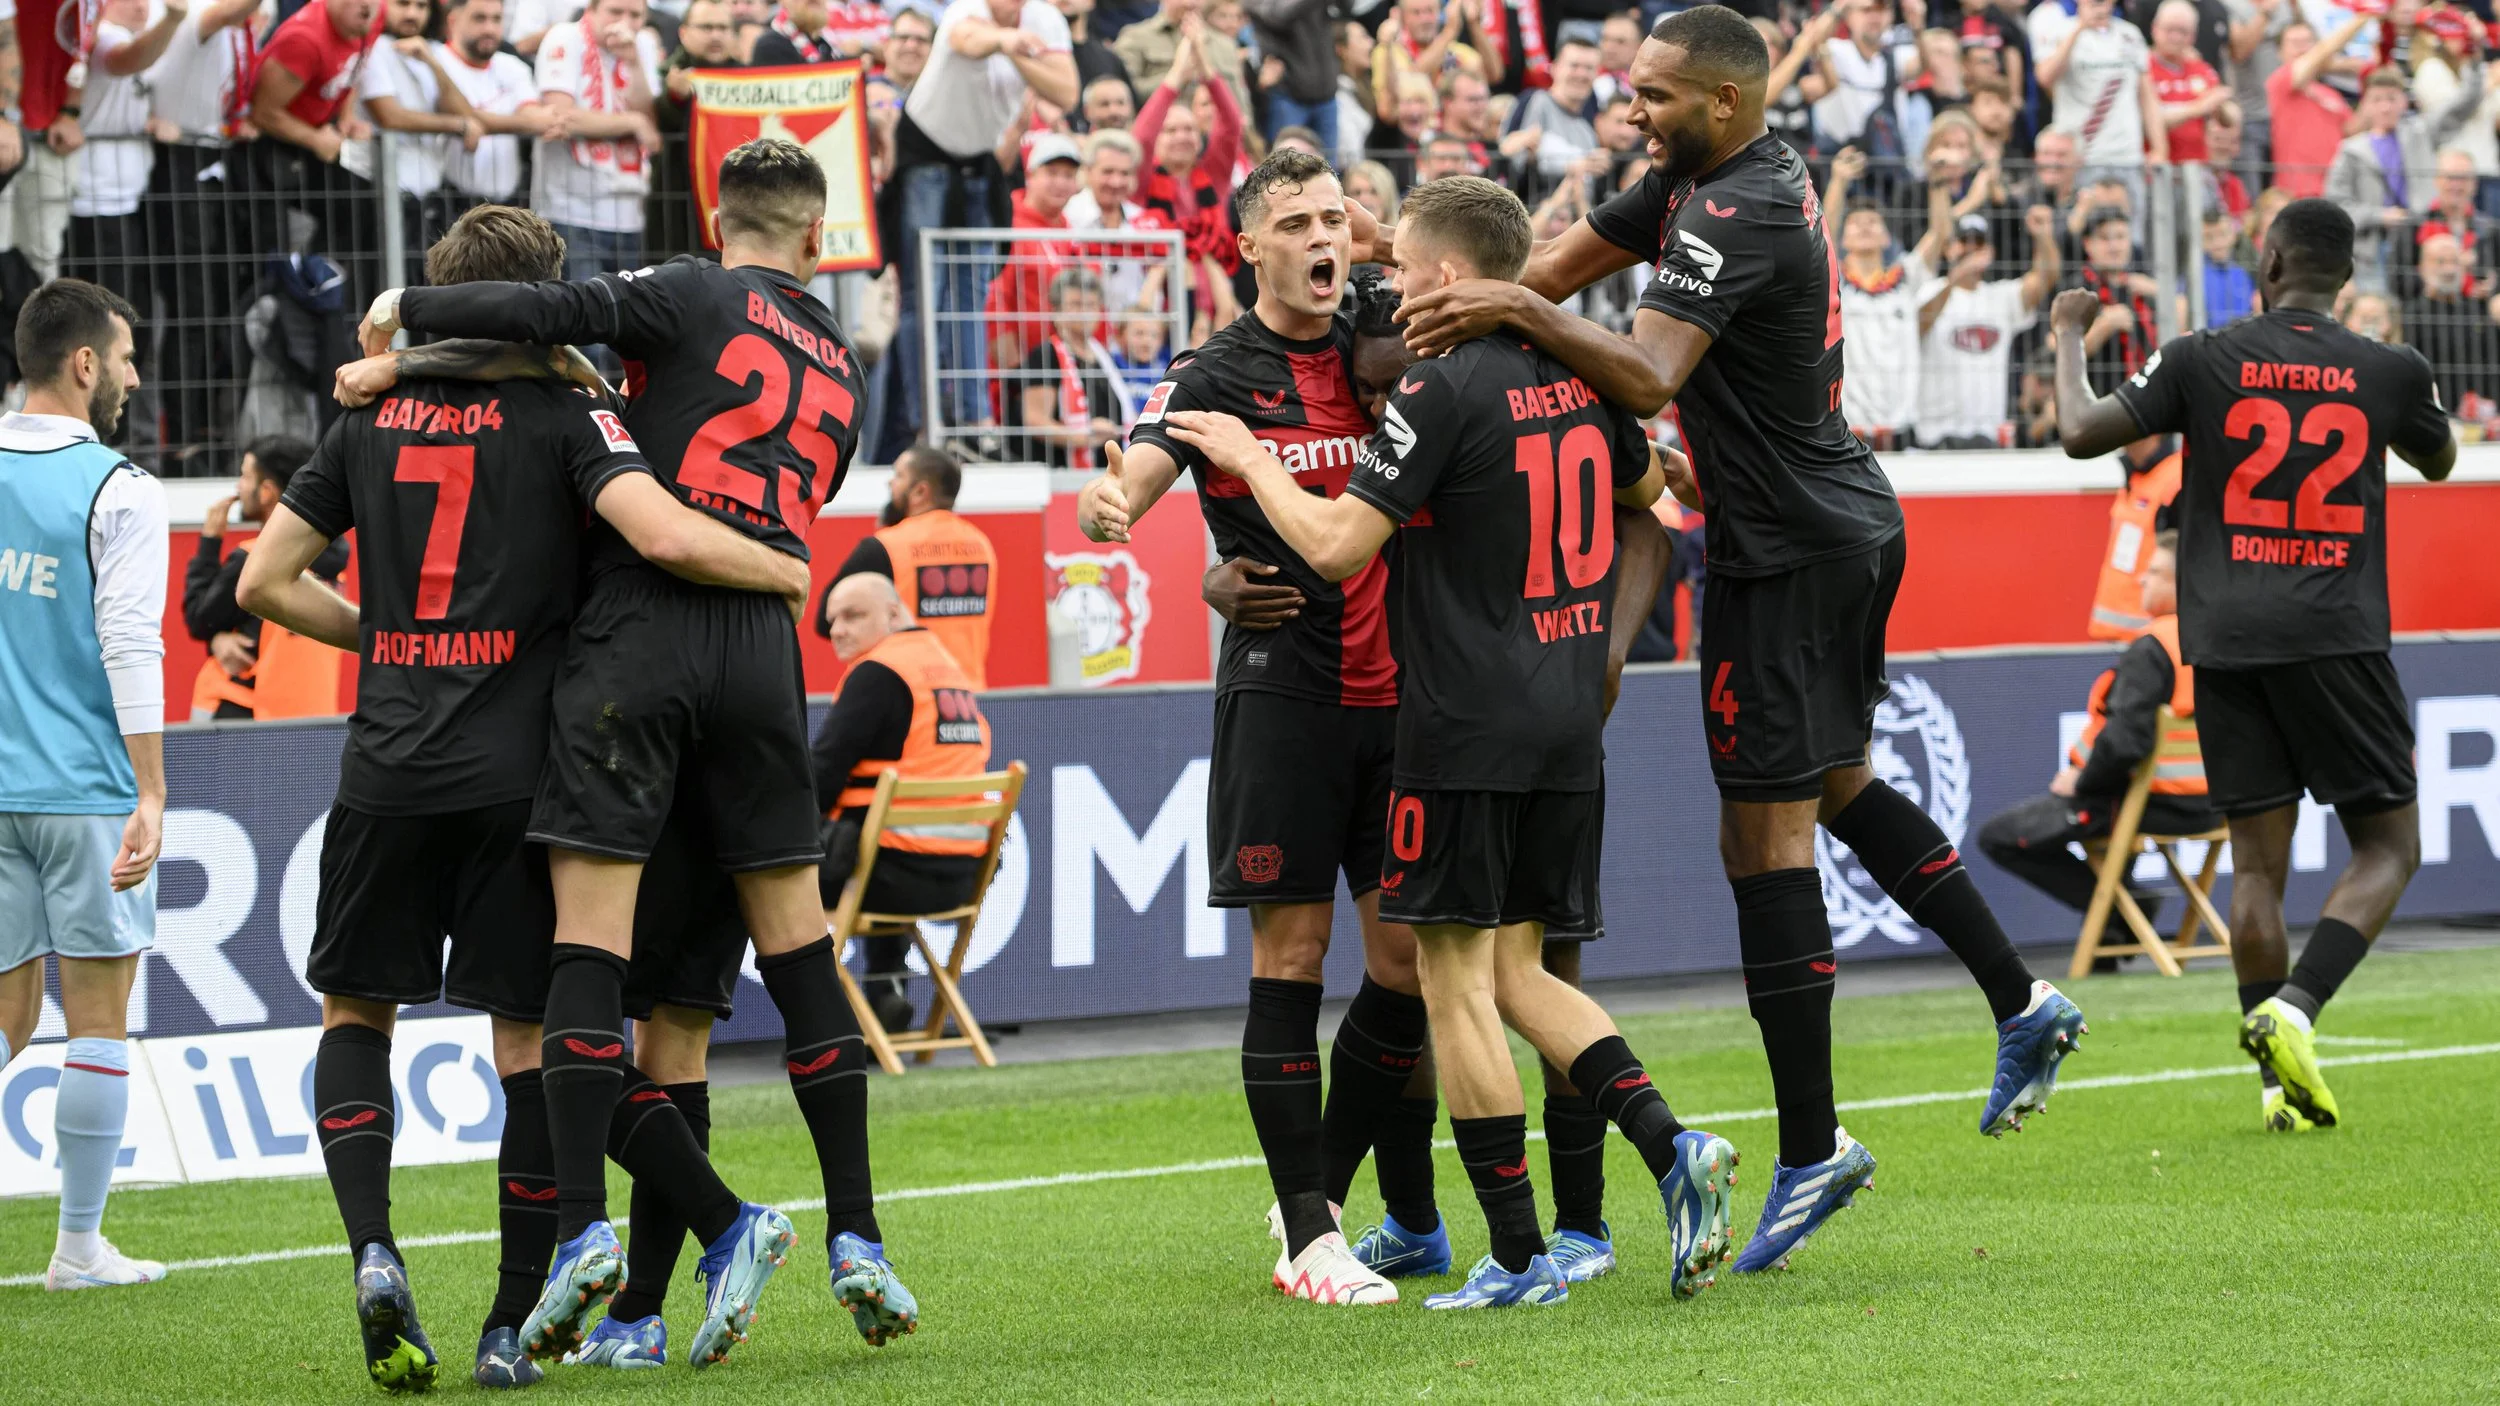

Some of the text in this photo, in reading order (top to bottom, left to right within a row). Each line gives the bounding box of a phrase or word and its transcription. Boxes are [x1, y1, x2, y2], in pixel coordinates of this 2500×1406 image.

[1658, 267, 1712, 296] trive
[675, 333, 855, 539] 25
[1359, 448, 1400, 481] trive
[2223, 397, 2369, 534] 22
[393, 445, 475, 620] 7
[1515, 424, 1615, 599] 10
[2232, 535, 2349, 567] BONIFACE
[372, 630, 515, 667] HOFMANN
[1709, 661, 1739, 726] 4
